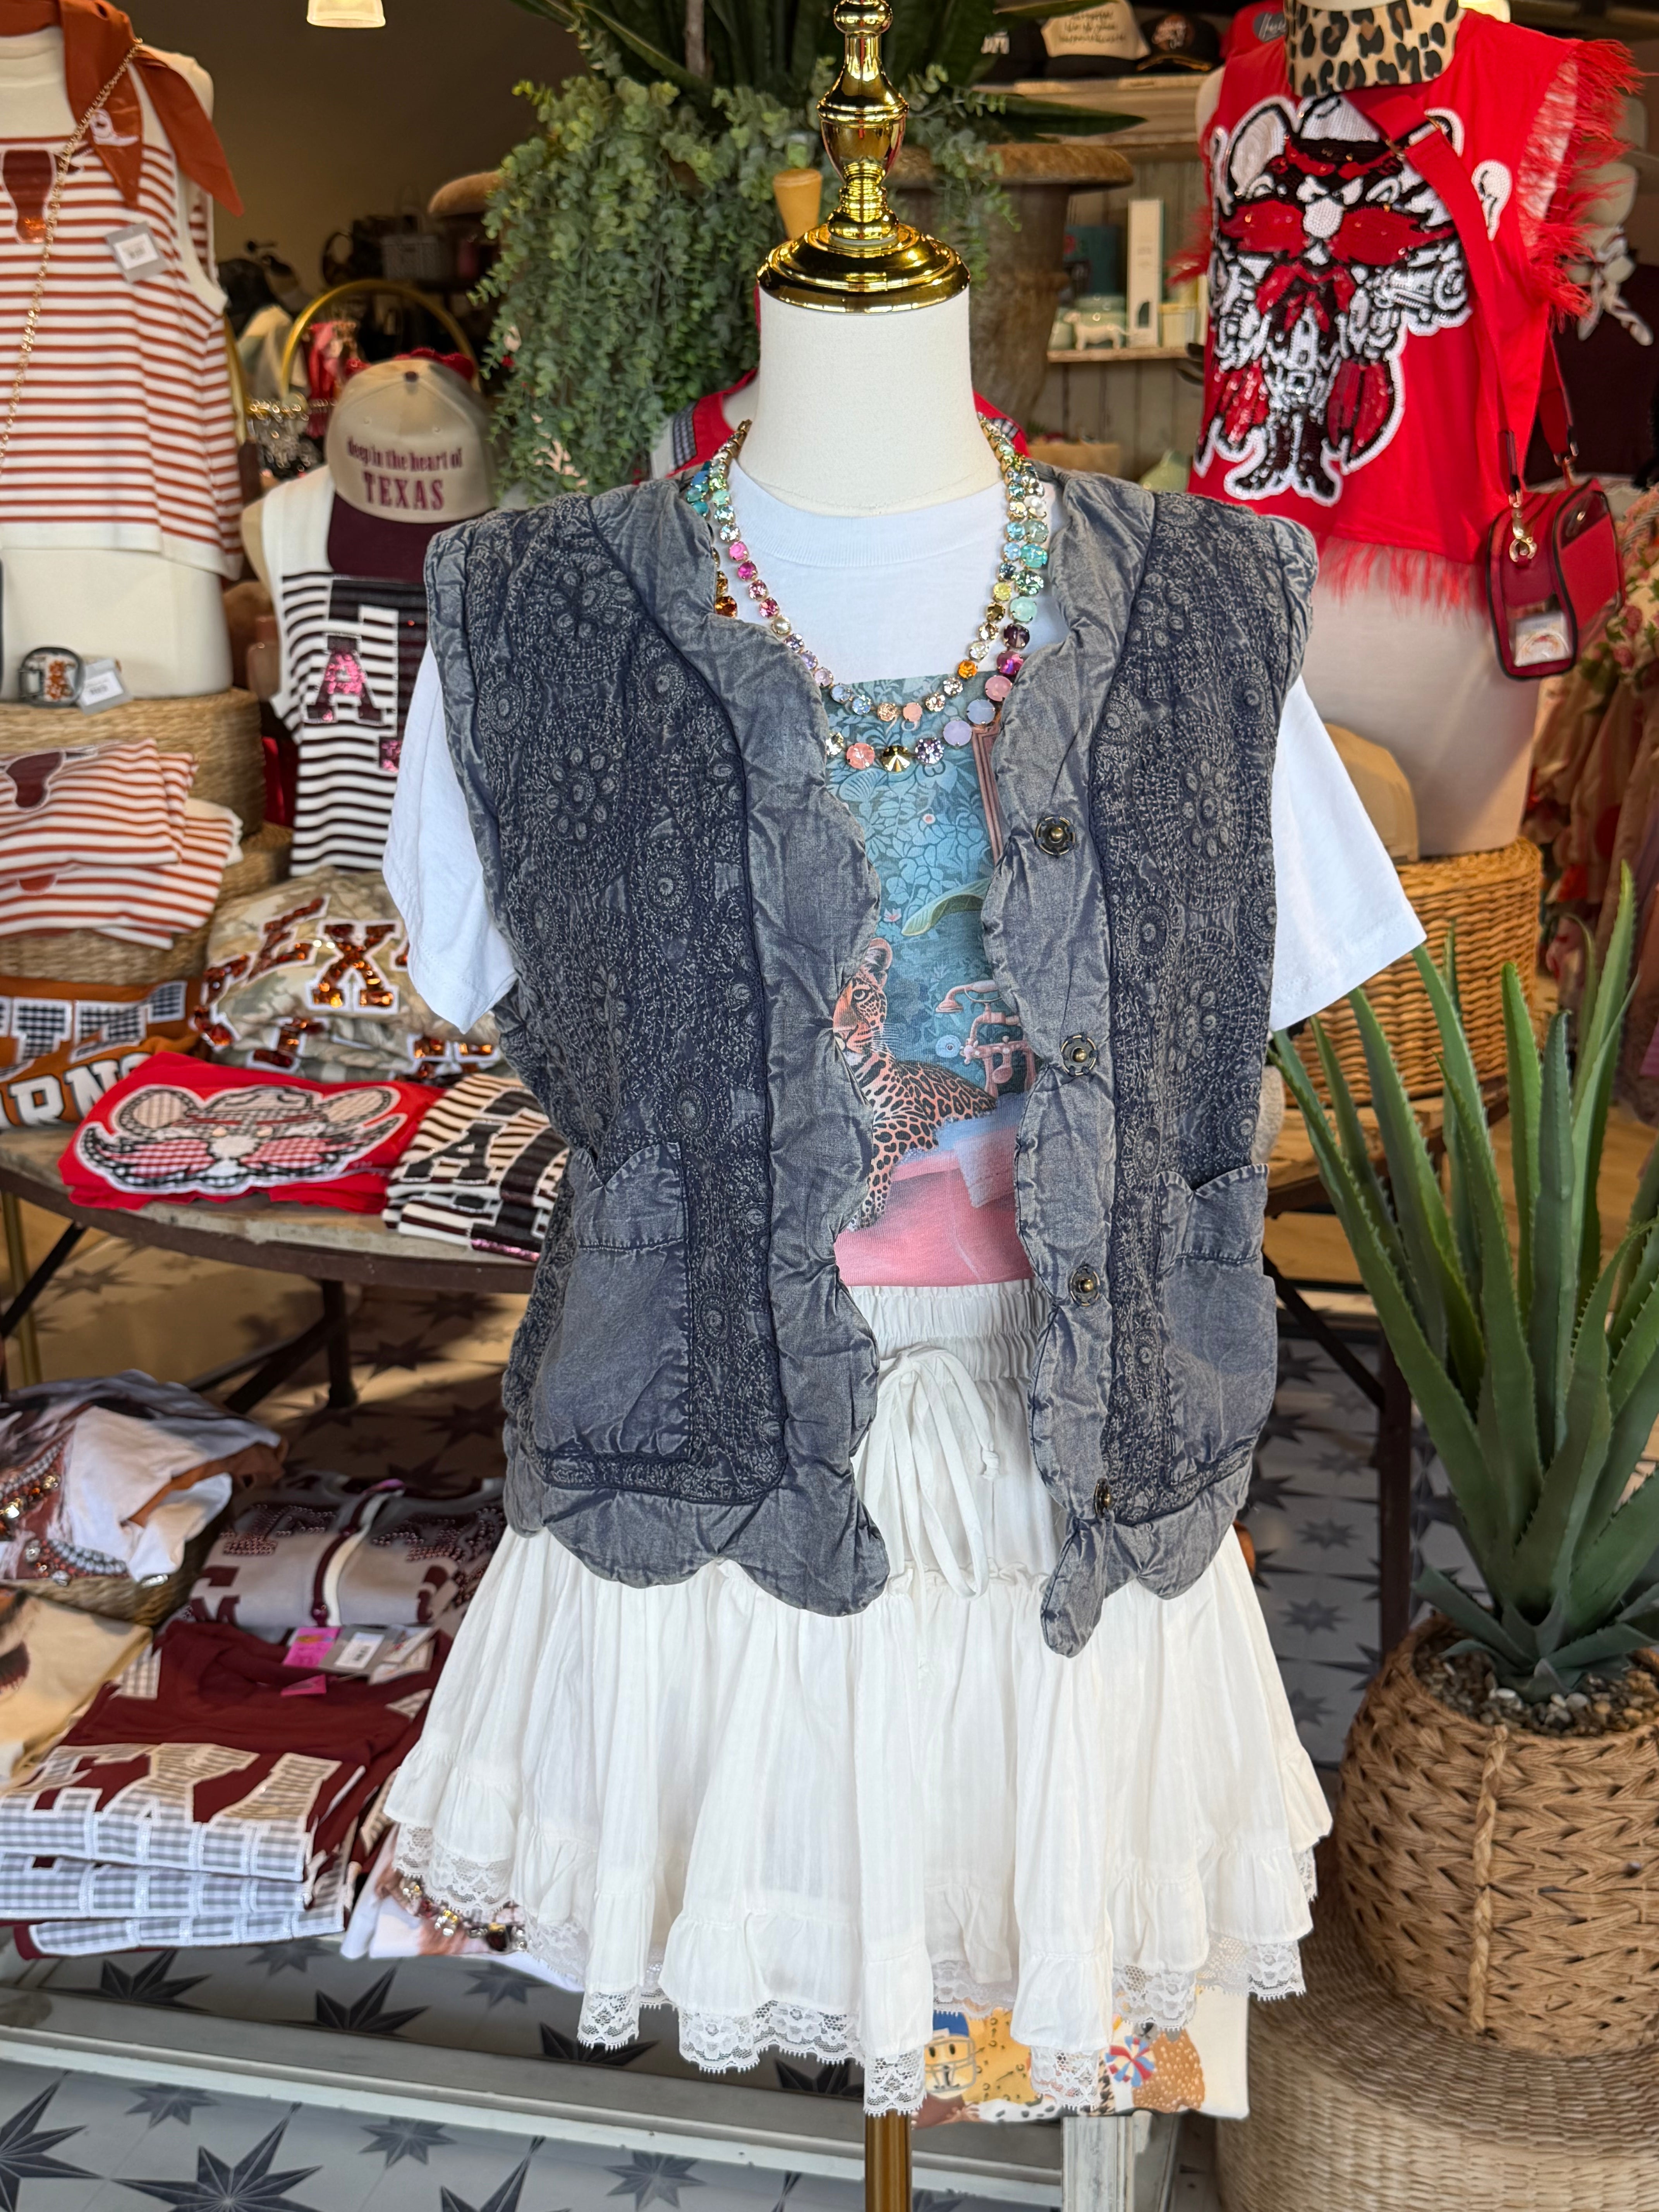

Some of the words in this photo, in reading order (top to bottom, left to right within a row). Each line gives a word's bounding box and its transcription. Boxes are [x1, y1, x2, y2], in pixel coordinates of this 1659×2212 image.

[371, 445, 383, 467] in
[385, 450, 406, 471] the
[409, 449, 448, 472] heart
[450, 447, 462, 468] of
[362, 470, 444, 510] TEXAS
